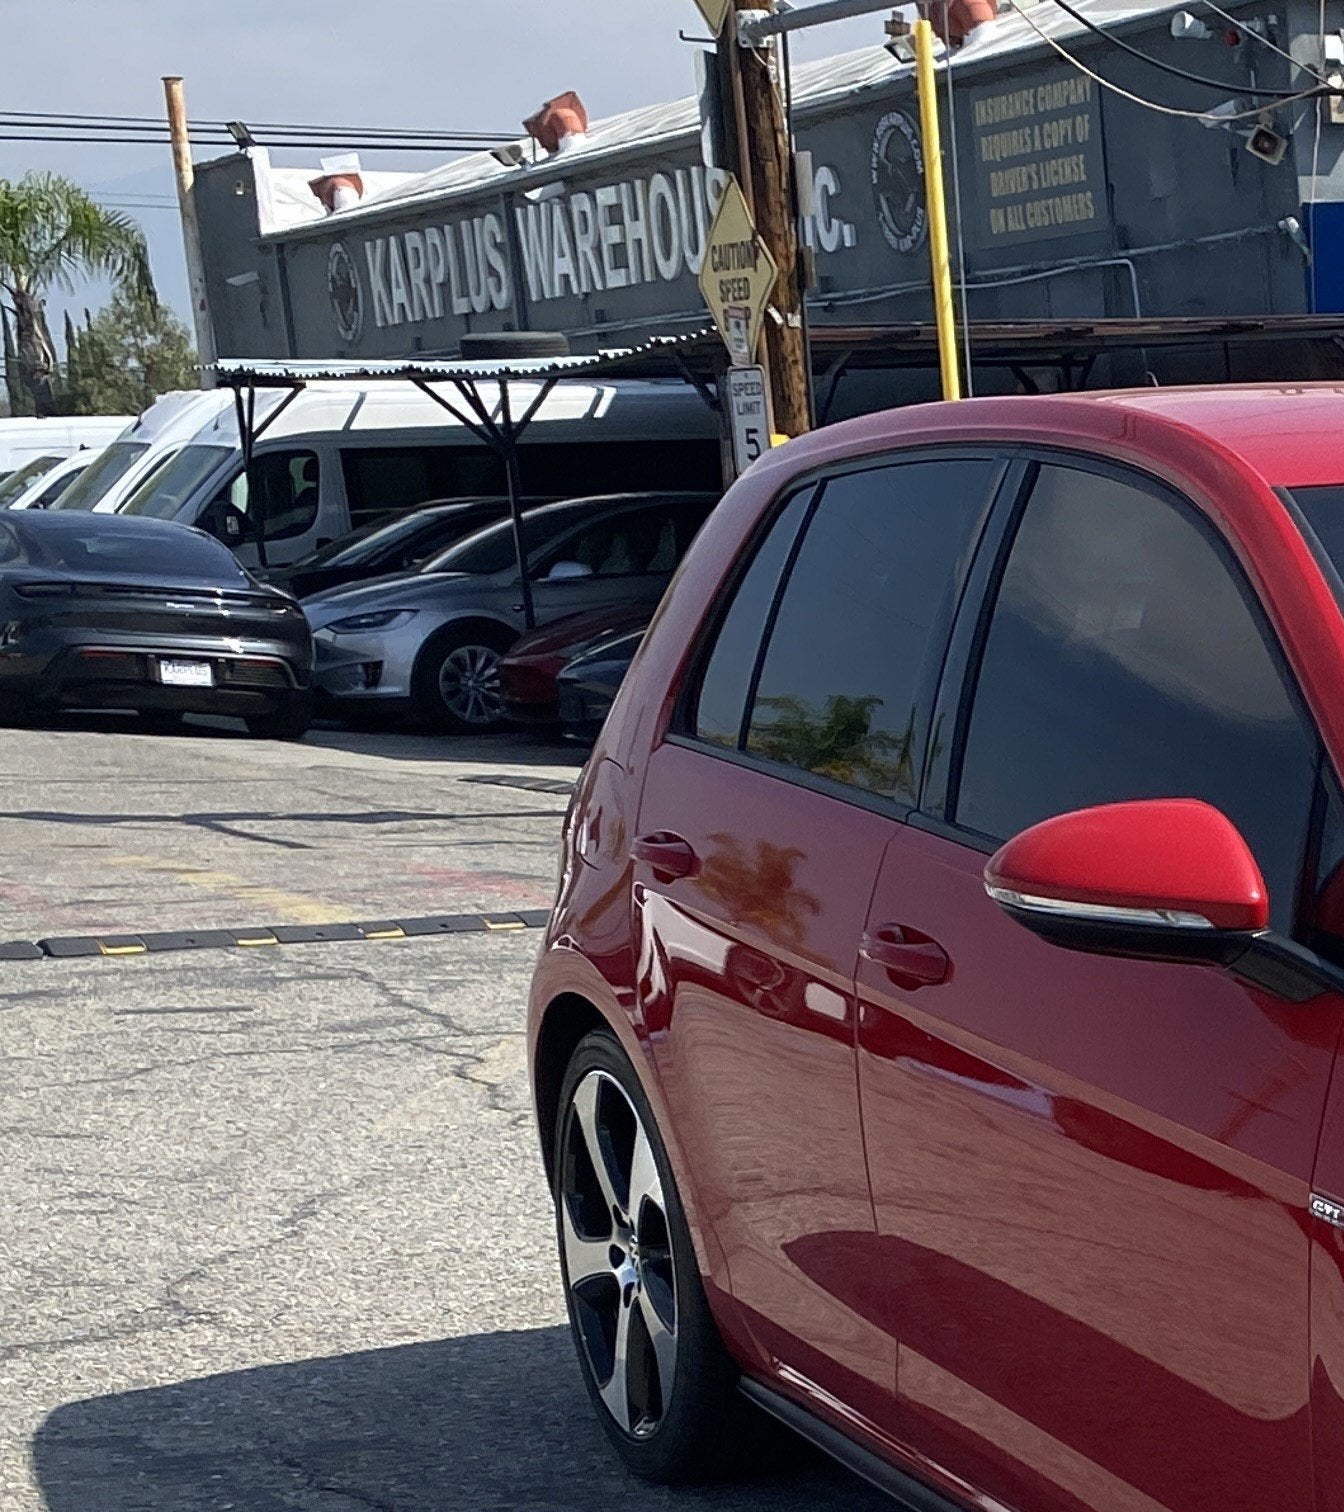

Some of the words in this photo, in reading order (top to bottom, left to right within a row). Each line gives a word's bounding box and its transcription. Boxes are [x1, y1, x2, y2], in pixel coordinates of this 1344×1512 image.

[975, 88, 1035, 126] INSURANCE
[1037, 75, 1091, 113] COMPANY
[981, 126, 1032, 162] REQUIRES
[1033, 125, 1042, 151] A
[1043, 118, 1073, 149] COPY
[1075, 114, 1090, 143] OF
[990, 163, 1039, 197] DRIVER'S
[1040, 154, 1086, 188] LICENSE
[990, 207, 1006, 234] ON
[1006, 204, 1026, 231] ALL
[1026, 191, 1094, 228] CUSTOMERS
[365, 212, 511, 328] KARPLUS
[711, 240, 753, 273] CAUTION
[718, 276, 751, 302] SPEED
[732, 381, 762, 397] SPEED
[736, 400, 761, 416] LIMIT
[744, 428, 761, 461] 5
[1312, 1199, 1341, 1220] GTI
